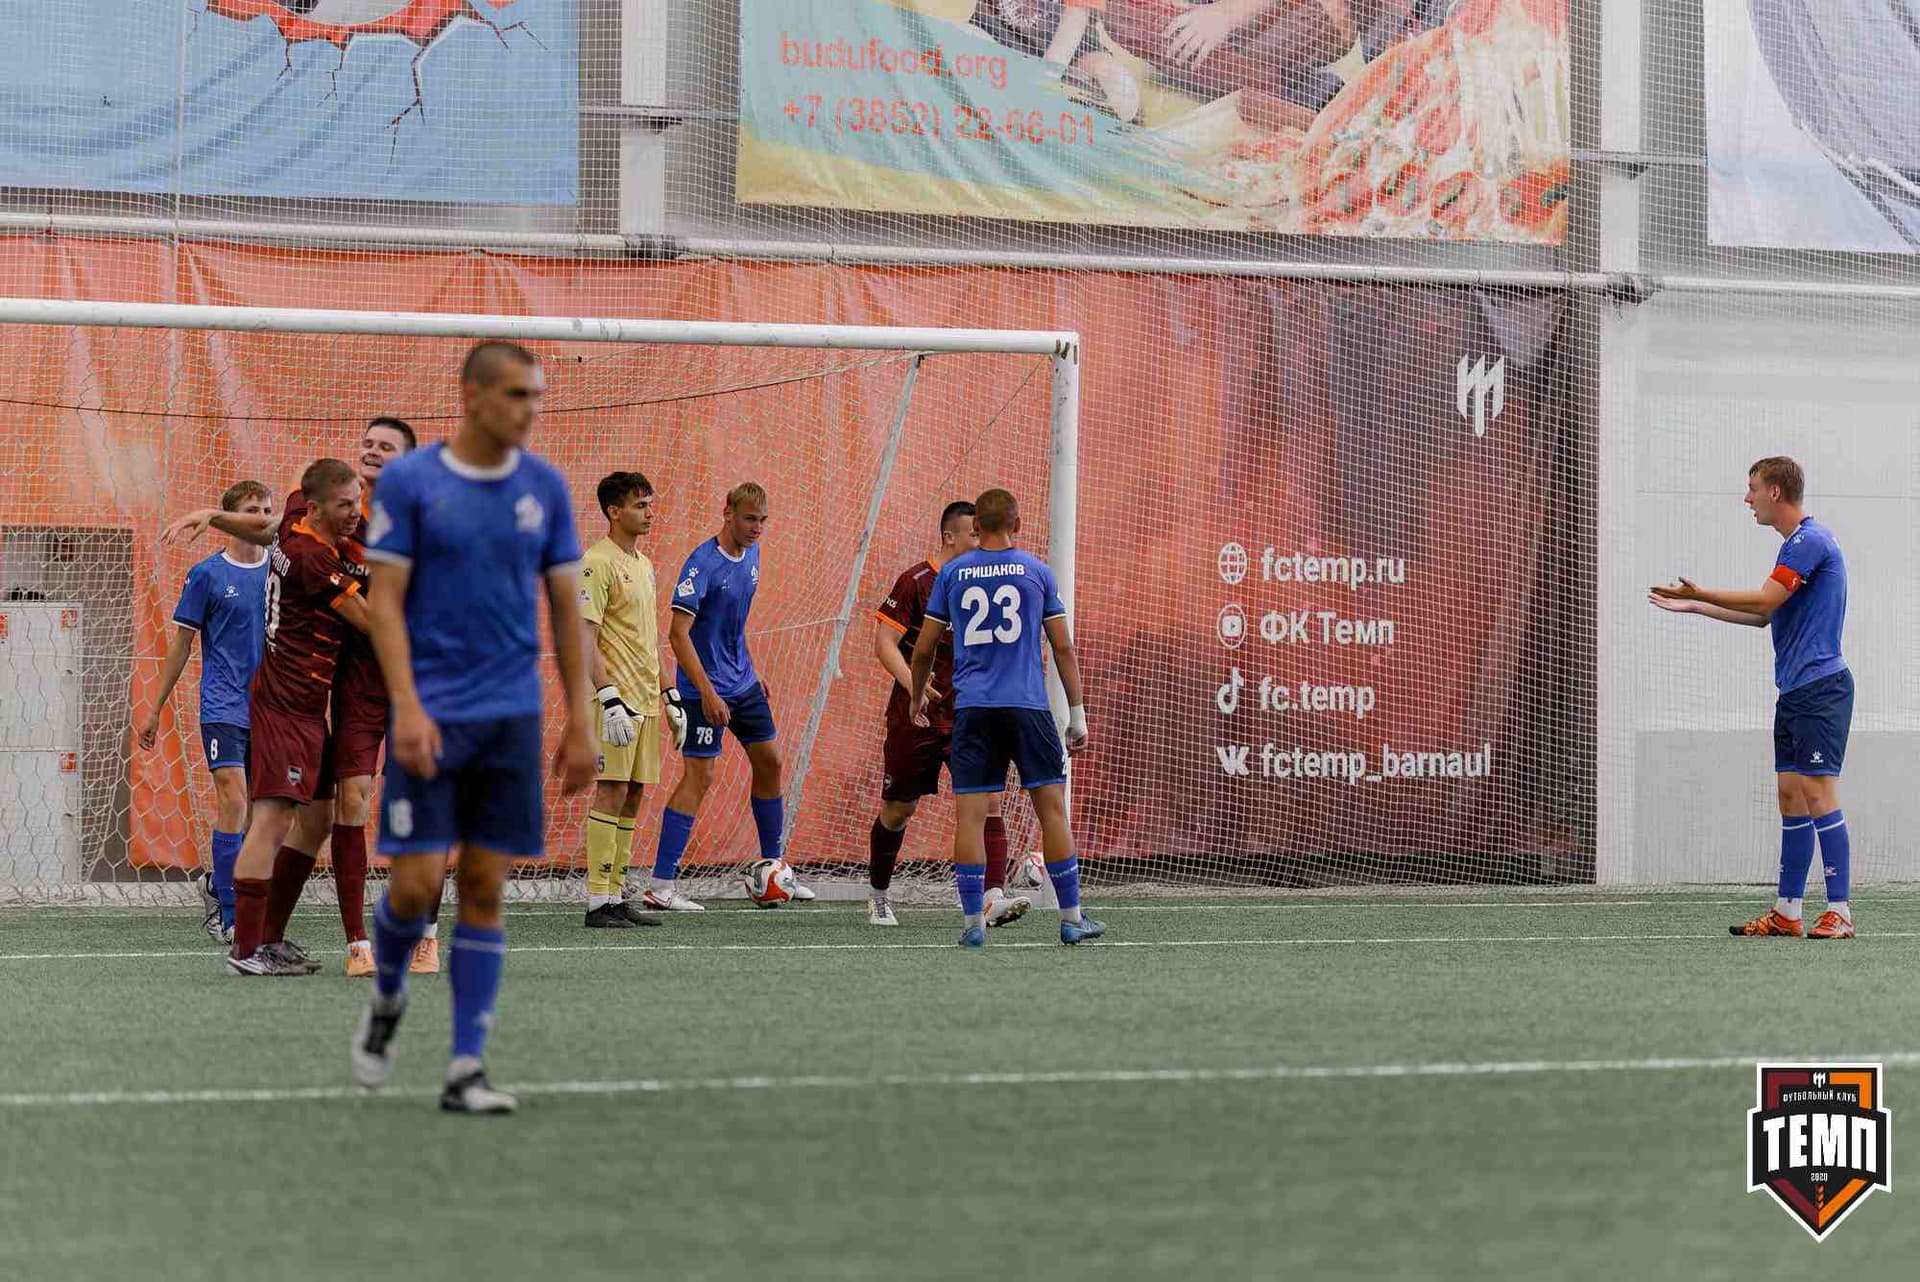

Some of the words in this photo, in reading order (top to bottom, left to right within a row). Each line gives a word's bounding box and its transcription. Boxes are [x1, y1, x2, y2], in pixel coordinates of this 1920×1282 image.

[780, 31, 1007, 89] budufood.org
[783, 94, 822, 128] +7
[835, 96, 942, 140] (3852)
[952, 104, 1095, 146] 22-66-01
[1260, 547, 1405, 590] fctemp.ru
[961, 584, 1022, 647] 23
[1259, 610, 1310, 645] ФК
[1317, 611, 1395, 646] Темп
[1258, 676, 1376, 719] fc.temp
[210, 738, 219, 761] 8
[696, 726, 714, 745] 78
[1260, 742, 1492, 785] fctemp_barnaul
